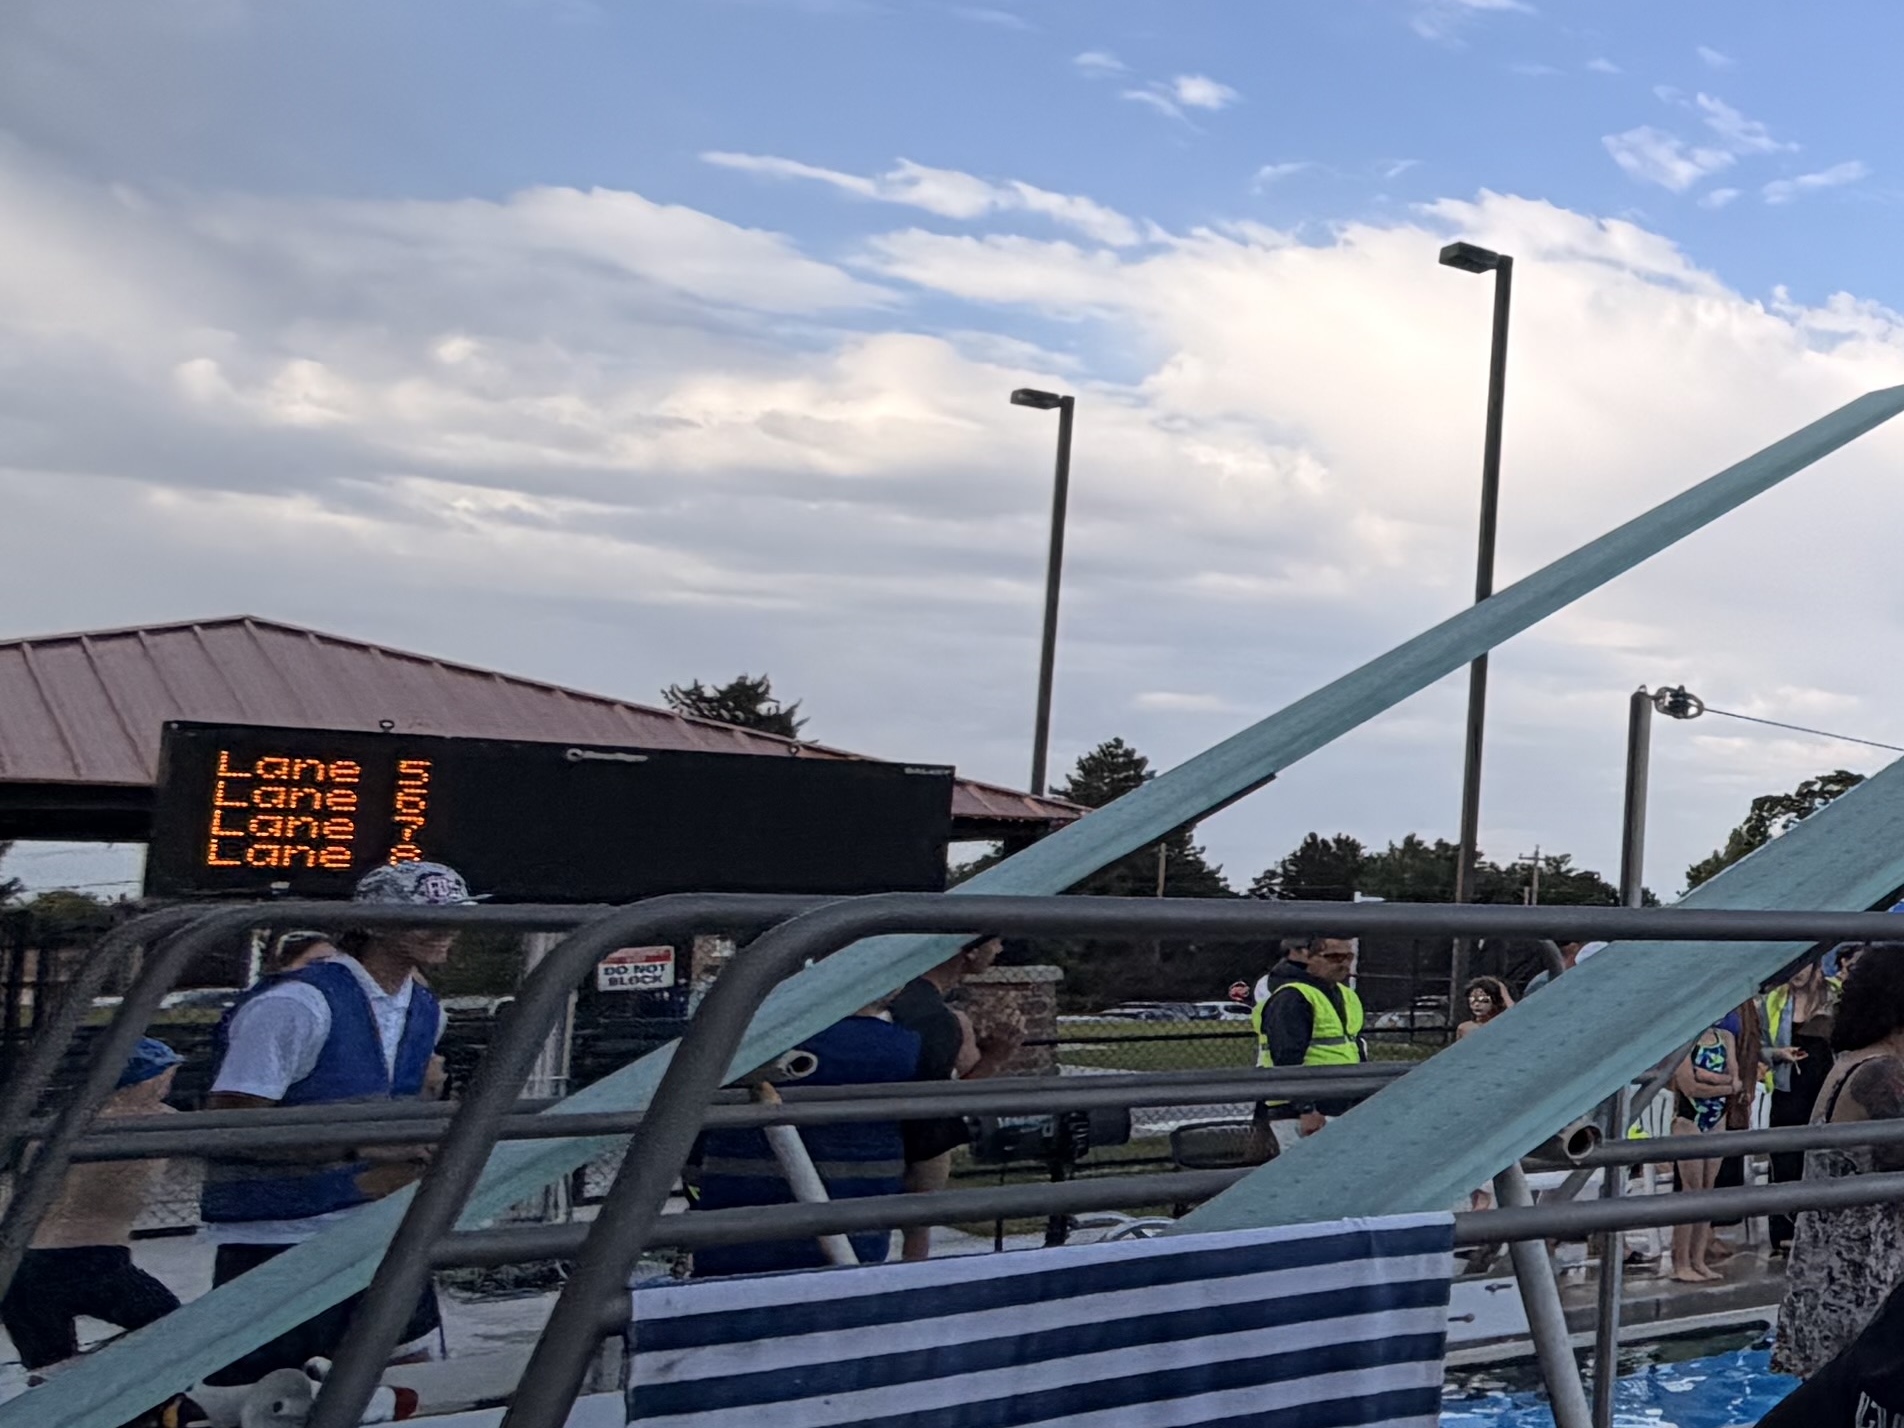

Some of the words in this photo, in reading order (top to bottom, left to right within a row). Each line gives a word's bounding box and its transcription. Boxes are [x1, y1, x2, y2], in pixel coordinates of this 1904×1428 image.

[217, 751, 362, 783] Lane
[397, 760, 432, 786] 5
[213, 780, 358, 811] Lane
[396, 788, 428, 814] 6
[210, 809, 355, 840] Lane
[394, 816, 426, 841] 7
[207, 838, 352, 868] Lane
[604, 965, 628, 976] DO
[633, 963, 665, 974] NOT
[608, 975, 663, 986] BLOCK
